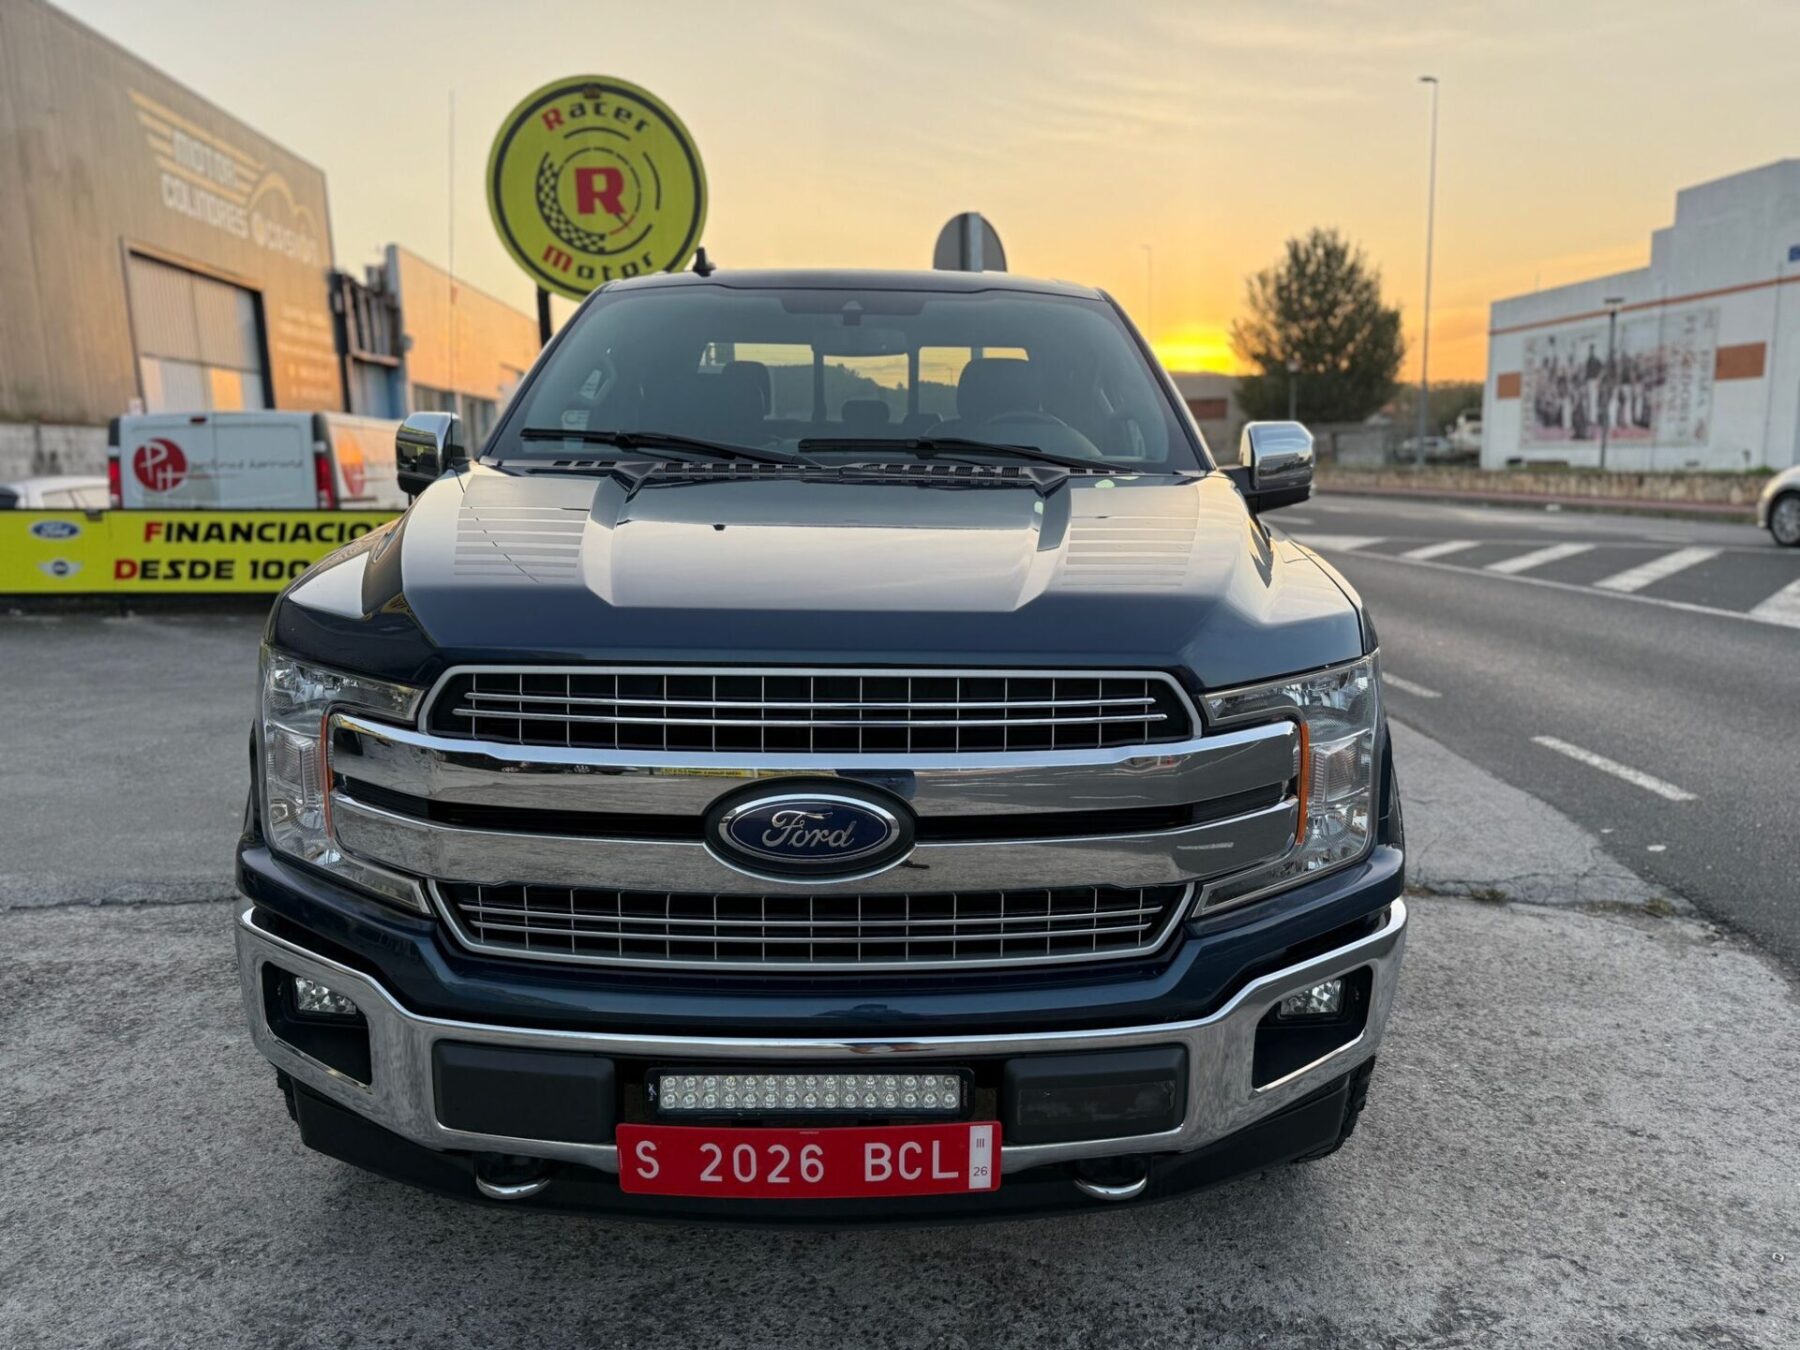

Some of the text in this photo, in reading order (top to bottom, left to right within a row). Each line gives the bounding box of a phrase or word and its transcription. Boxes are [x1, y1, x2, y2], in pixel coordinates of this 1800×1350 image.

[574, 166, 626, 216] R
[143, 521, 384, 543] FINANCIACIO
[113, 558, 236, 581] DESDE
[761, 809, 855, 848] Ford
[635, 1140, 959, 1184] S 2026 BCL
[973, 1166, 988, 1177] 26
